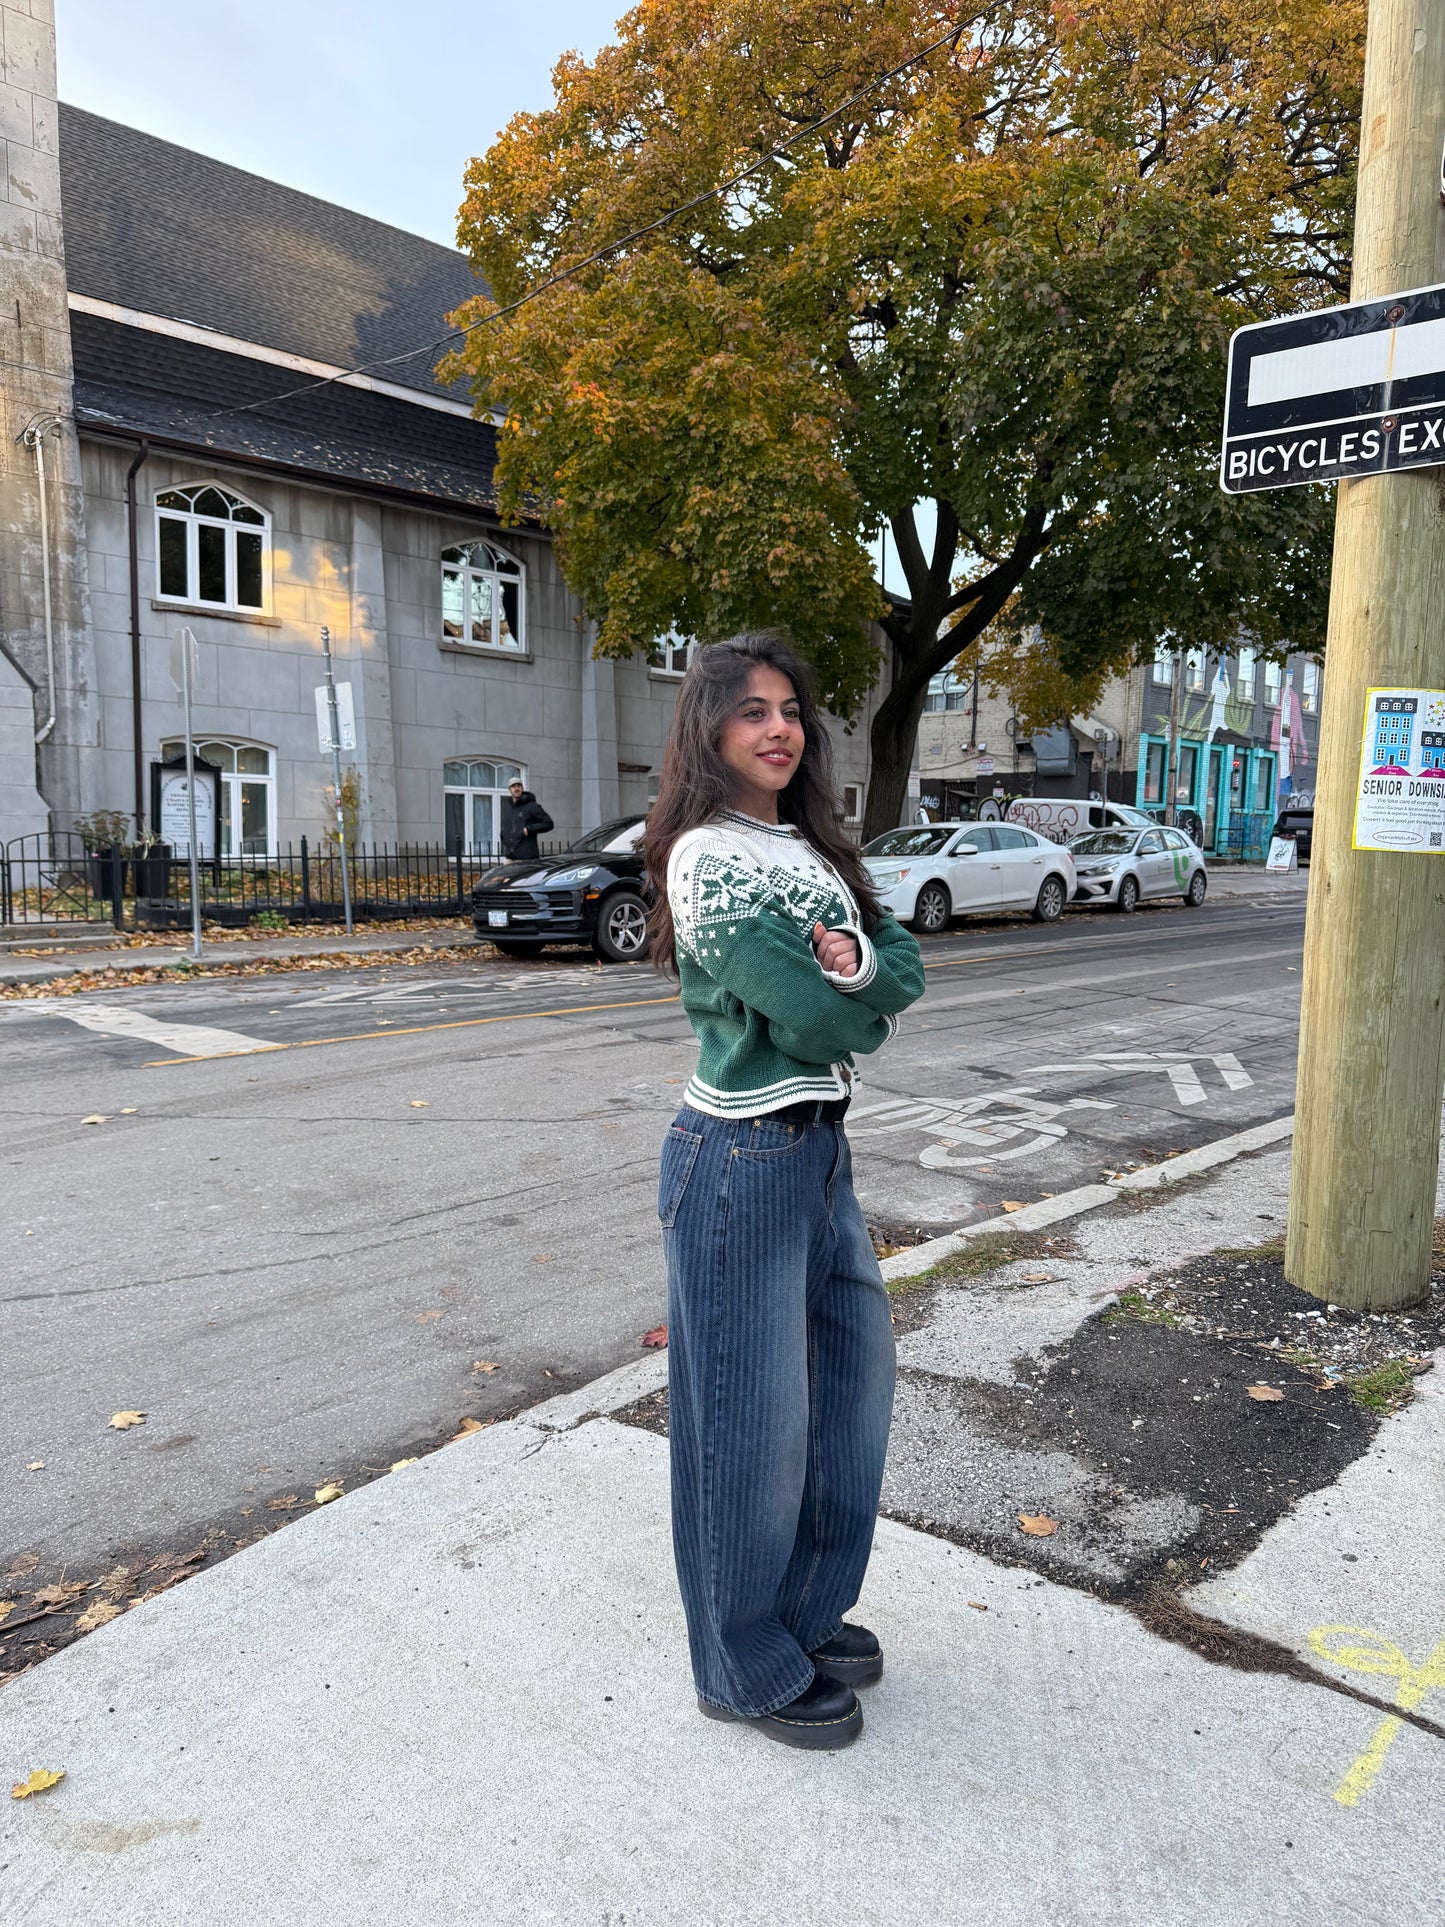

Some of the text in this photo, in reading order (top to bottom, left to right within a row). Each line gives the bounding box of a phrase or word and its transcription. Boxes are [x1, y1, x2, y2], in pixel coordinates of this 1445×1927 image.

[1228, 417, 1445, 480] BICYCLES EX
[1363, 779, 1445, 799] SENIOR DOWNSI
